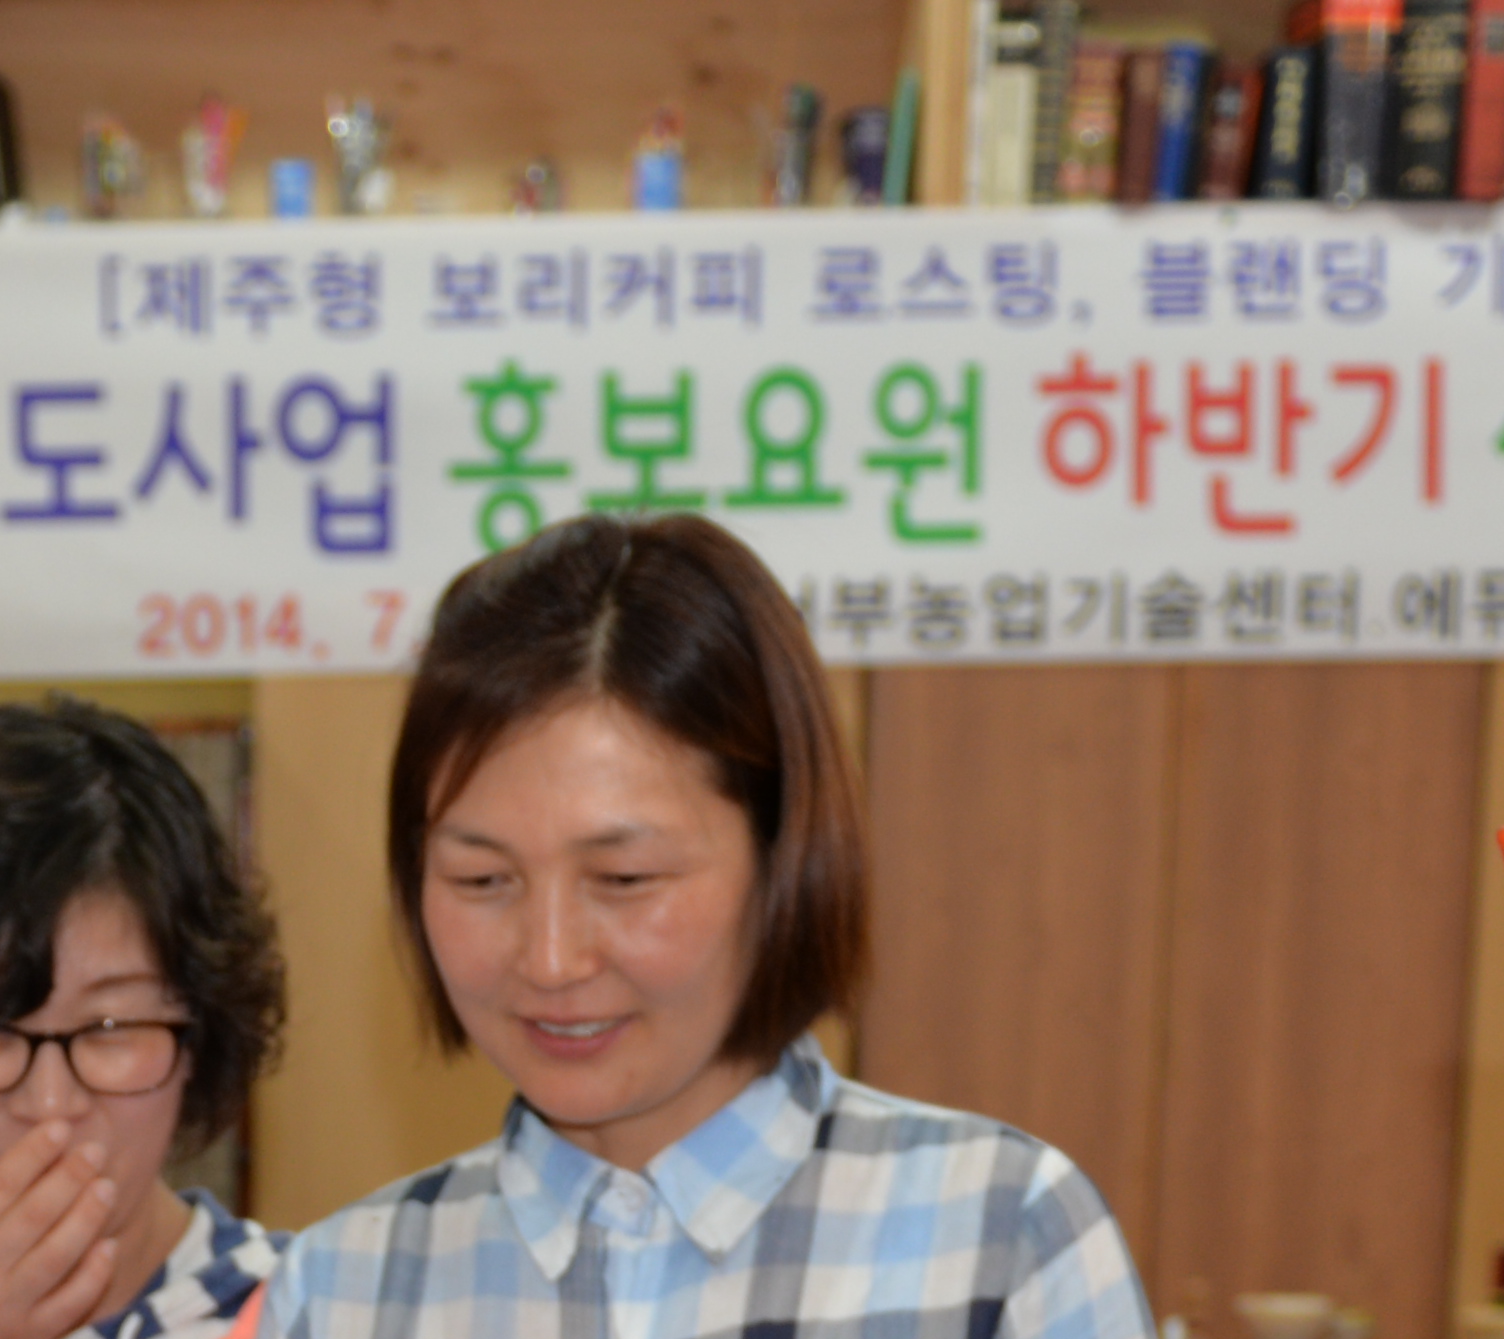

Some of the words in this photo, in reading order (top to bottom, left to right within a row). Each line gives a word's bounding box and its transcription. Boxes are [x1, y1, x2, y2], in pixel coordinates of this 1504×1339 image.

[99, 252, 382, 338] [제주형
[425, 248, 765, 331] 보리커피
[810, 238, 1092, 330] 로스팅,
[446, 358, 988, 553] 홍보요원
[1035, 352, 1444, 535] 하반기
[136, 590, 332, 662] 2014.
